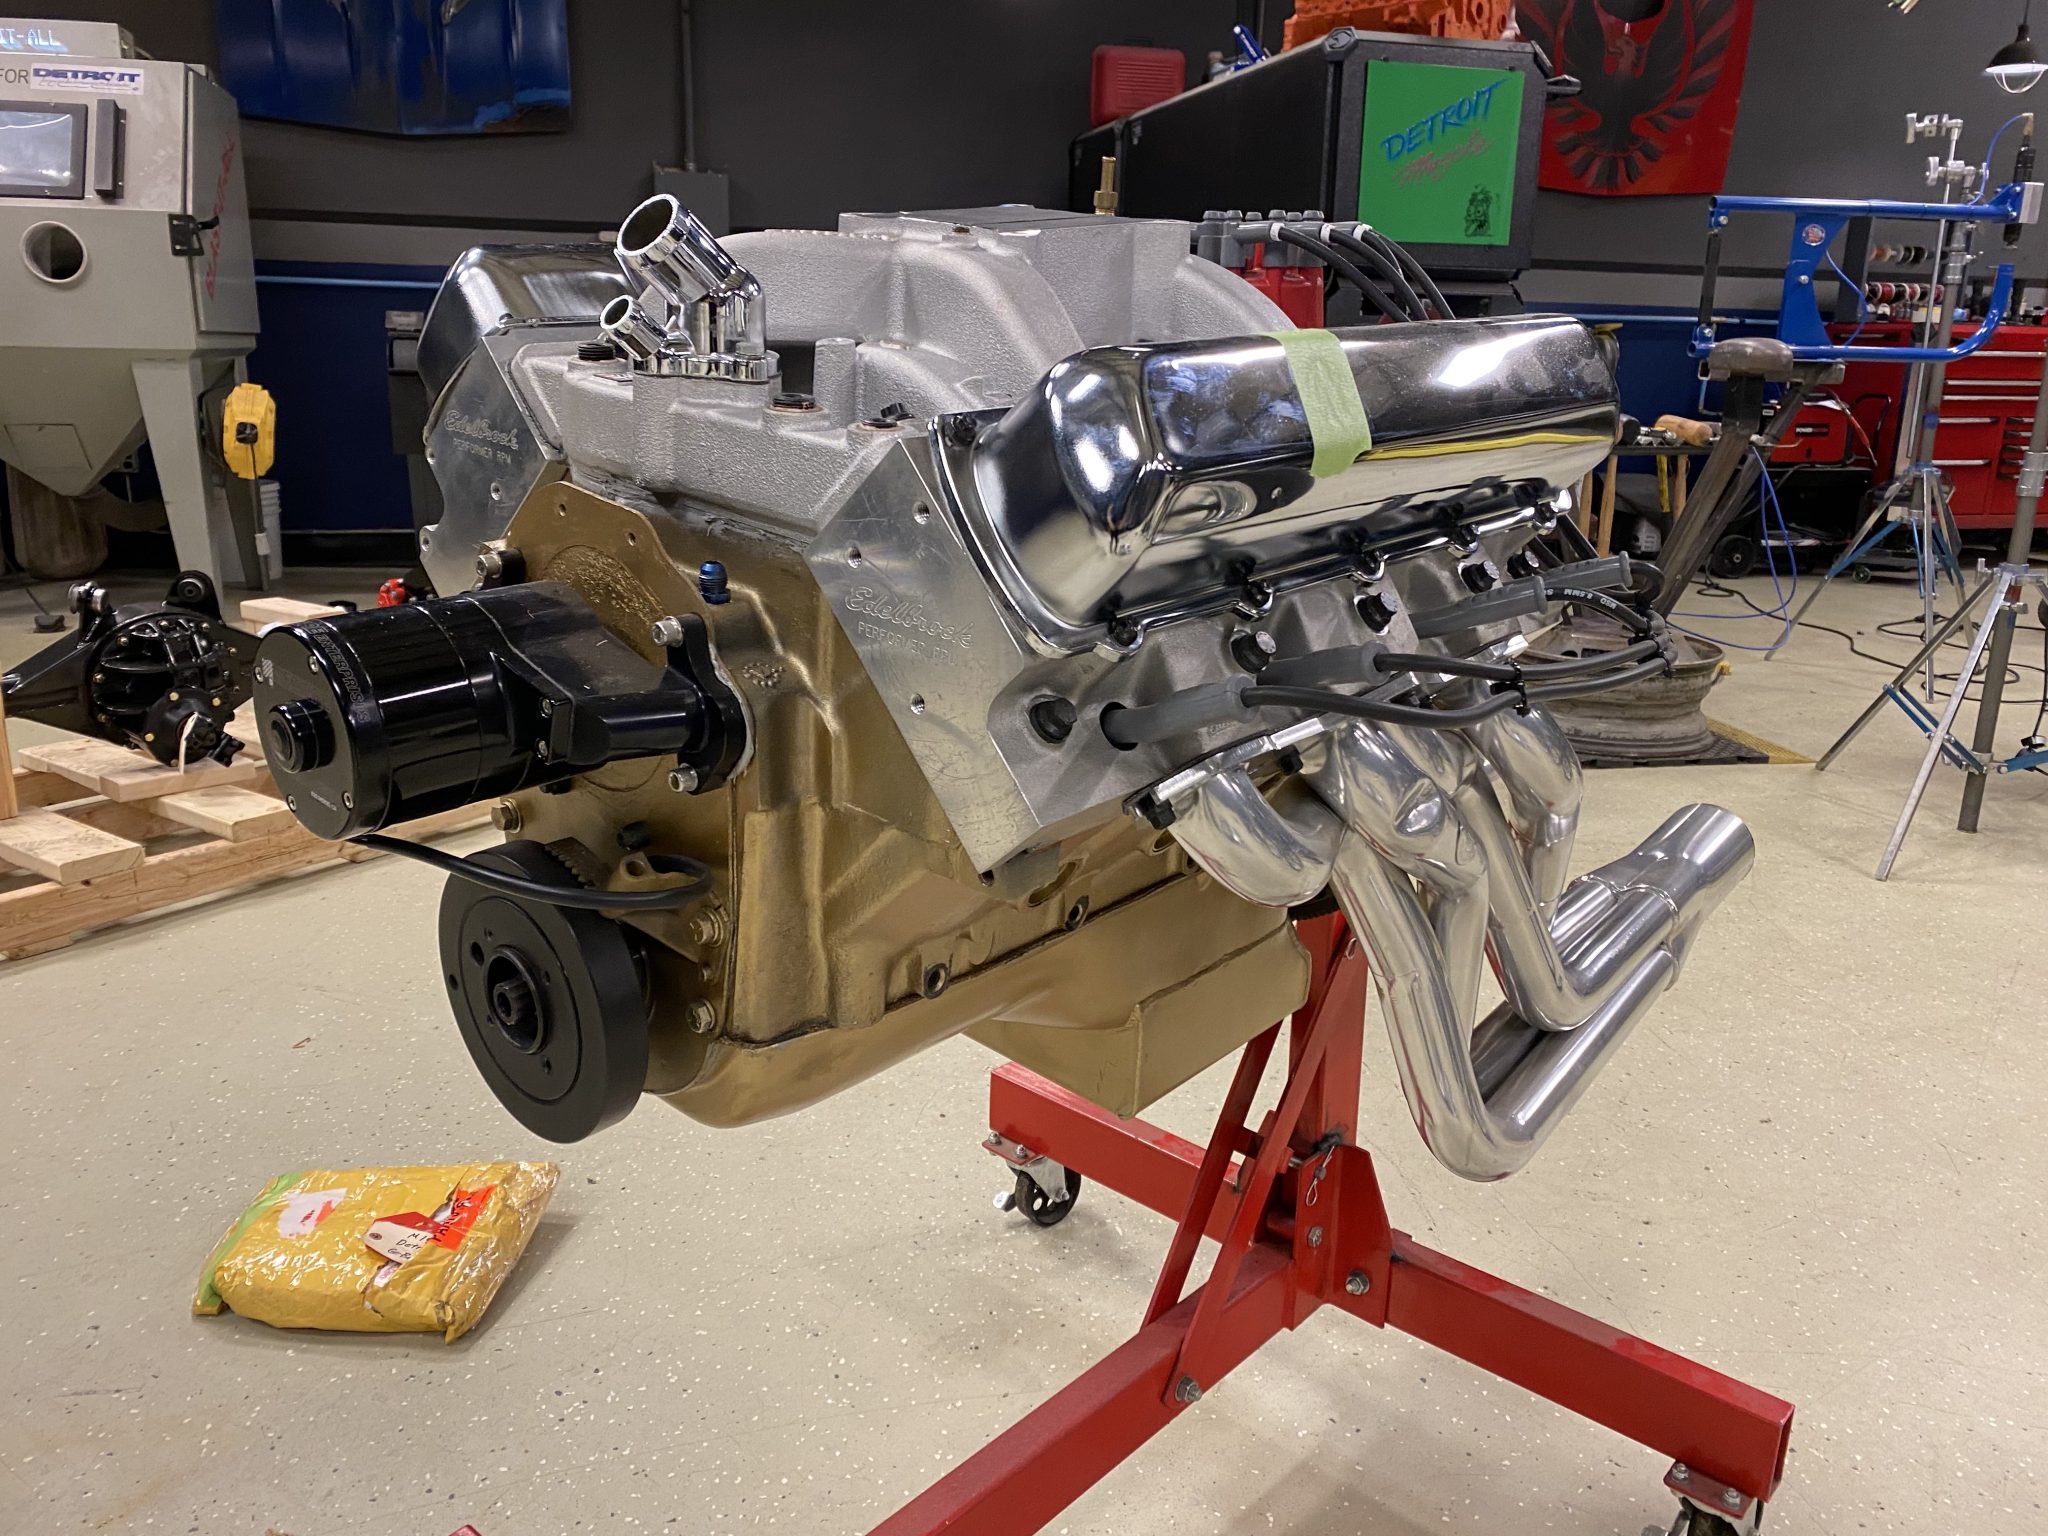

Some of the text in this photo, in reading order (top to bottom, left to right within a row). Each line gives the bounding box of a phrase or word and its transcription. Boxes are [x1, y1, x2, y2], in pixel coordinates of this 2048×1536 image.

[32, 67, 141, 83] DETROIT
[1381, 77, 1510, 162] DETROIT
[444, 410, 519, 449] Edelbrock
[1563, 588, 1594, 600] 8.5MM
[1599, 597, 1617, 610] MSD
[845, 586, 975, 649] Edelbrock
[858, 621, 926, 656] PERFORMER
